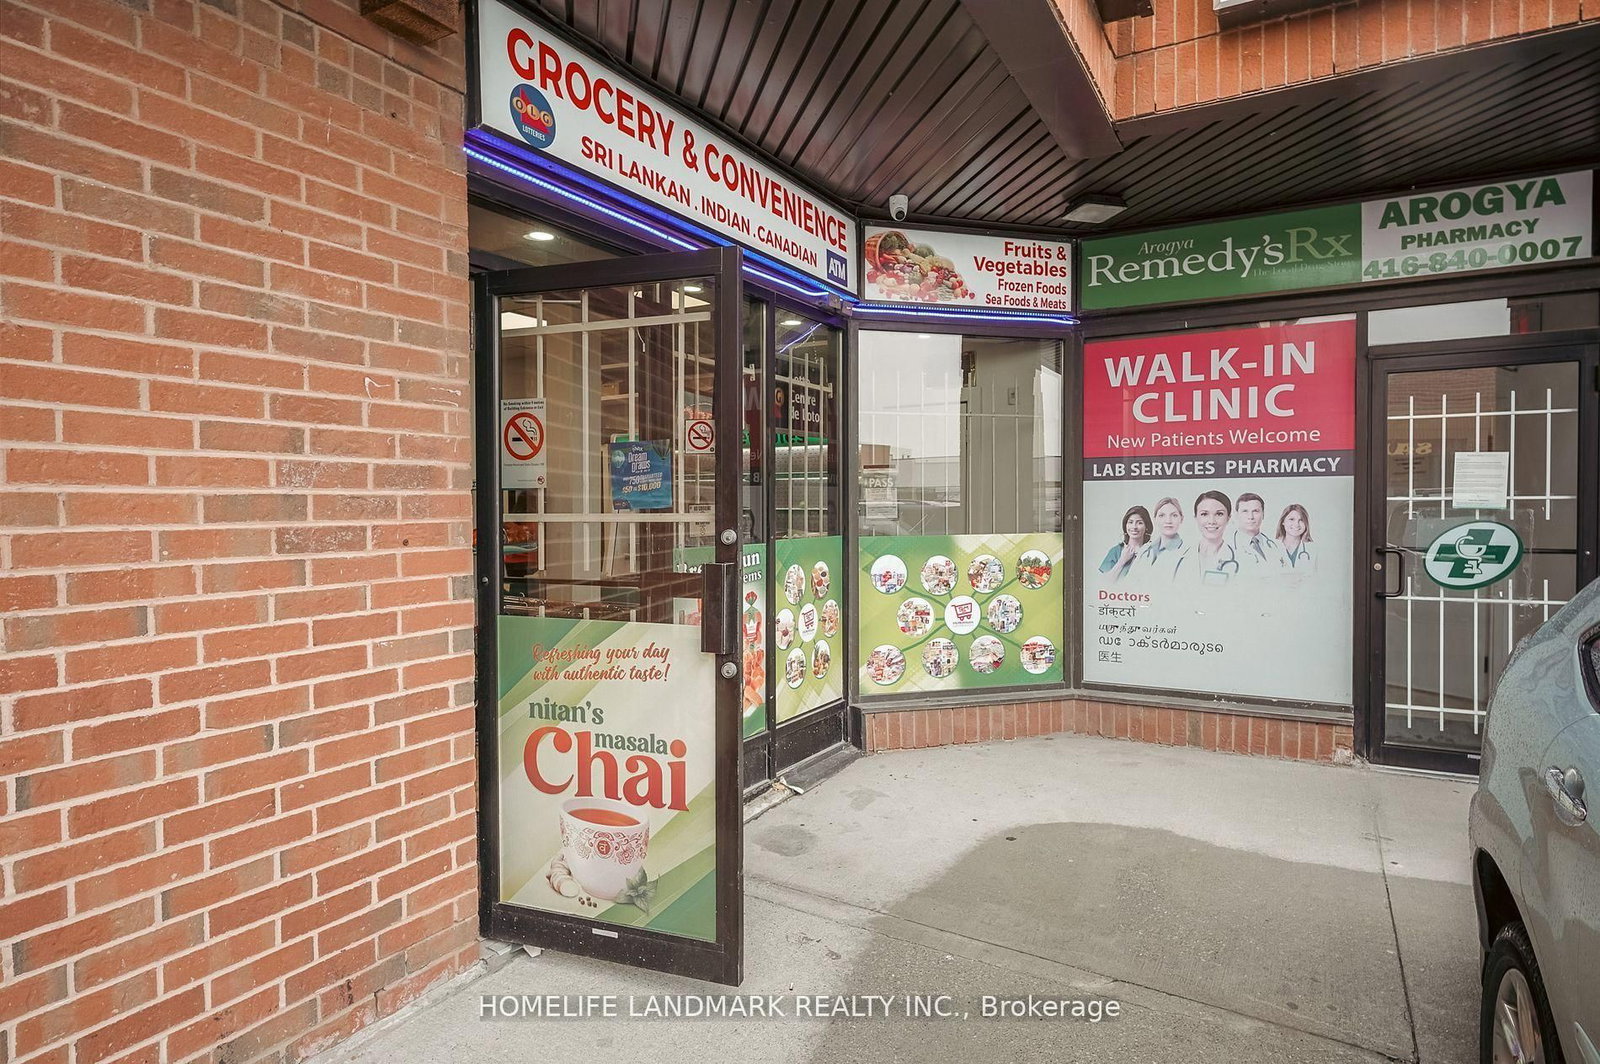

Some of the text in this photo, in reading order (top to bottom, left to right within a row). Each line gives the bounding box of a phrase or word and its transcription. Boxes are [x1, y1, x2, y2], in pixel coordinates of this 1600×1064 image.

[514, 98, 551, 126] OLG
[507, 27, 848, 253] GROCERY & CONVENIENCE
[522, 124, 546, 142] LOTTERIES
[581, 136, 614, 170] SRI
[618, 155, 691, 211] LANKAN
[701, 195, 751, 237] INDIAN
[1378, 177, 1566, 229] AROGYA
[1401, 217, 1540, 250] PHARMACY
[1004, 241, 1067, 261] Fruits &
[1138, 238, 1195, 256] Arogya
[1363, 235, 1583, 280] 416-840-0007
[828, 255, 847, 282] ATM
[973, 255, 1067, 278] Vegetables
[997, 278, 1067, 296] Frozen Foods
[985, 293, 1067, 311] Sea Foods & Meats
[1104, 341, 1316, 387] WALK-IN
[792, 389, 816, 406] enre
[1132, 383, 1296, 424] CLINIC
[1107, 427, 1321, 449] New Patients Welcome
[1093, 457, 1341, 477] LAB SERVICES PHARMACY
[869, 478, 894, 488] PASS
[743, 552, 761, 568] un
[743, 571, 762, 583] ems
[1099, 590, 1150, 602] Doctors
[532, 642, 671, 664] Refreshing your day
[1098, 651, 1123, 663] 医生
[533, 663, 671, 682] with authentic taste!
[528, 697, 605, 725] nitan's
[594, 732, 669, 755] masala
[523, 726, 690, 812] Chai
